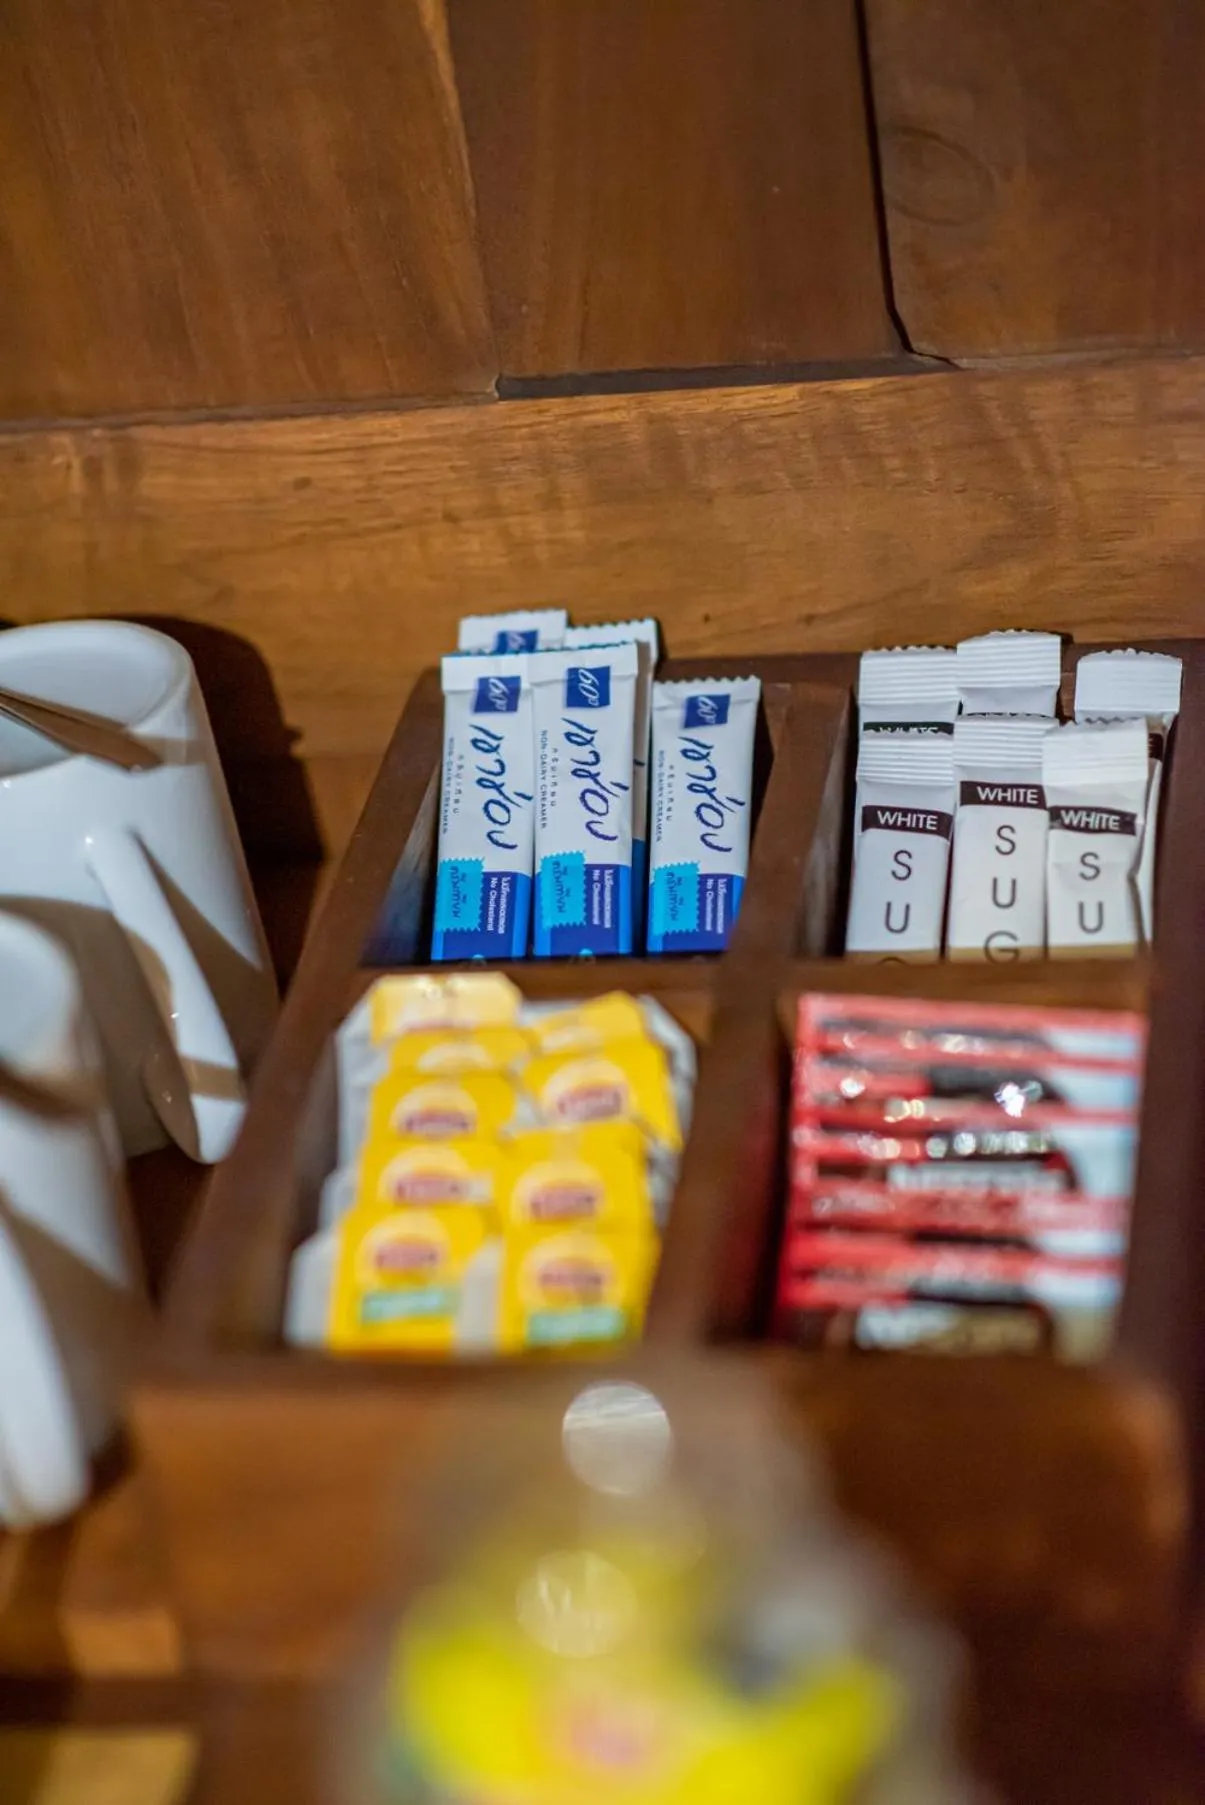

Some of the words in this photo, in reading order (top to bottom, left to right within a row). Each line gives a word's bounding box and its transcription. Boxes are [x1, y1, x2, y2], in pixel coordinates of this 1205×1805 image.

[469, 724, 533, 850] เขาช่อง
[561, 717, 629, 841] เขาช่อง
[678, 736, 746, 853] เขาช่อง
[976, 785, 1039, 804] WHITE
[876, 810, 939, 831] WHITE
[1060, 809, 1121, 831] WHITE
